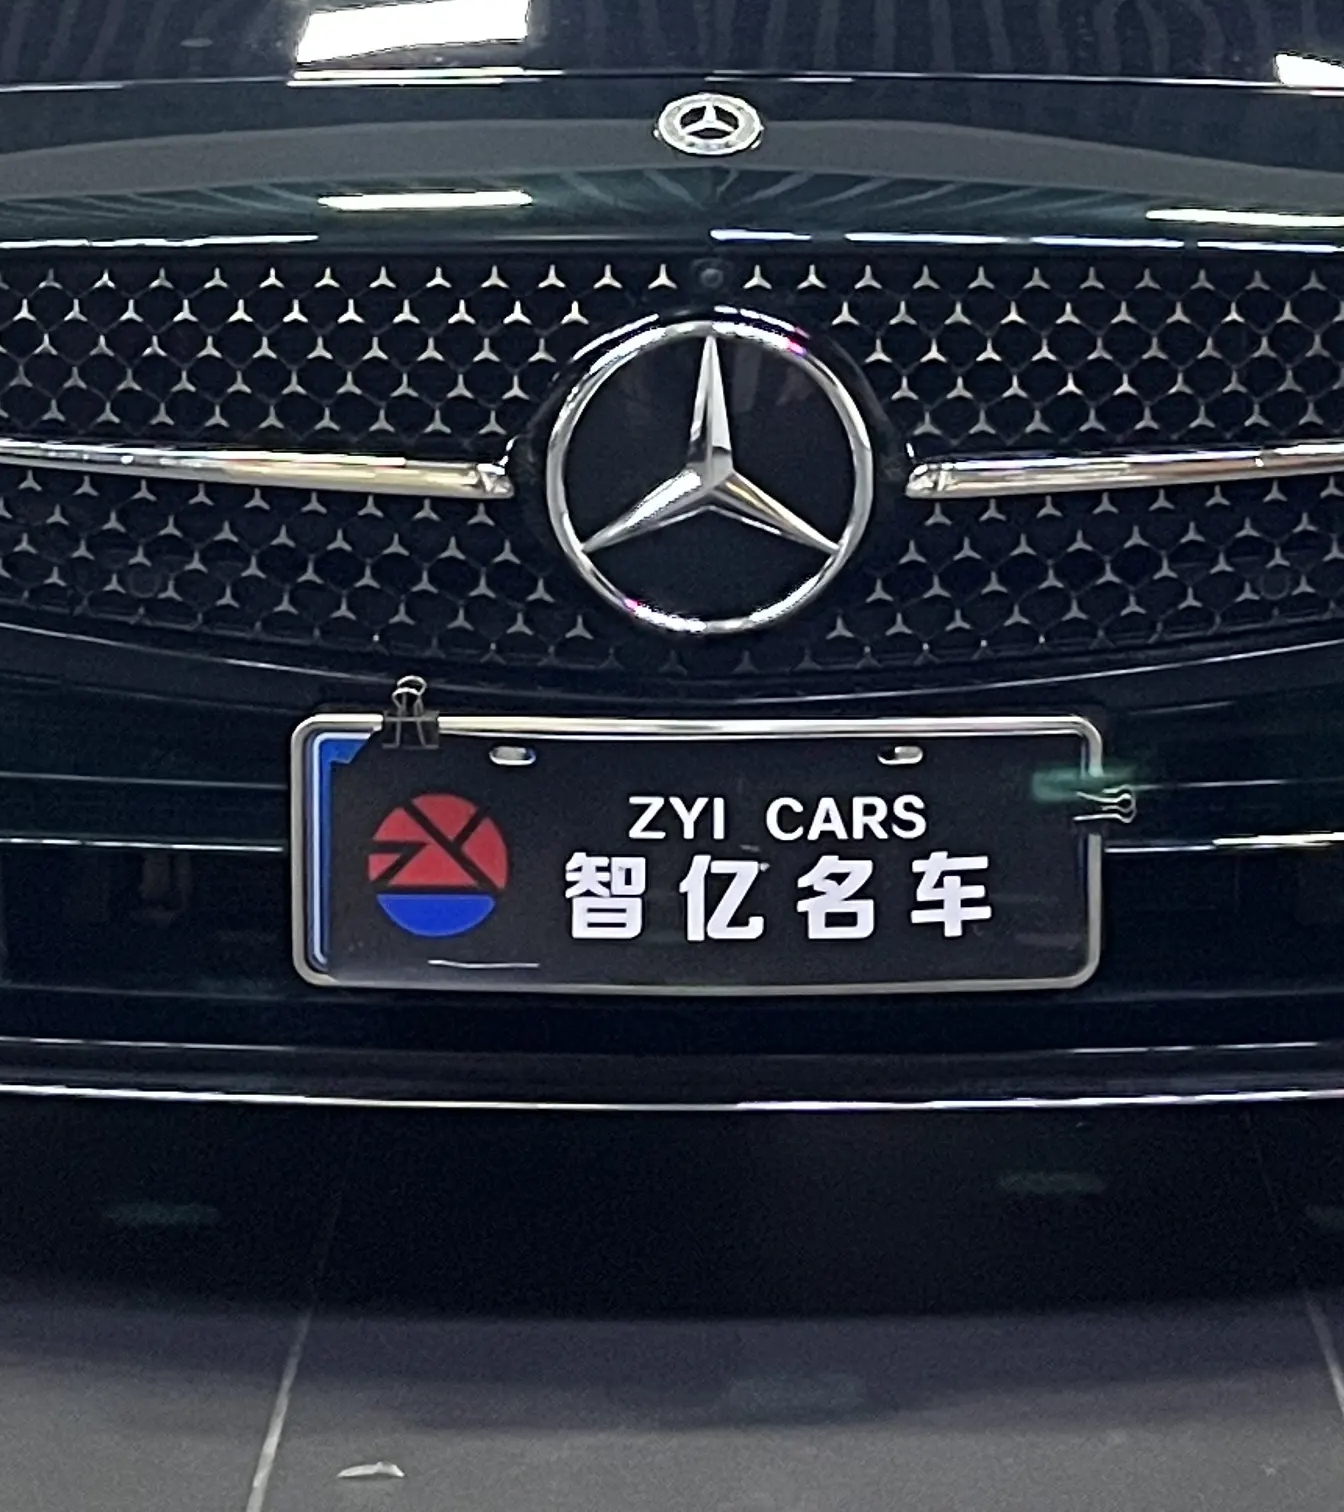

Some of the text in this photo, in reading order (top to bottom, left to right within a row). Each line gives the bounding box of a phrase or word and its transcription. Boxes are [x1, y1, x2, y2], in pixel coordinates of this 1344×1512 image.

[629, 794, 927, 841] ZYI CARS
[565, 851, 993, 942] 智亿名车
